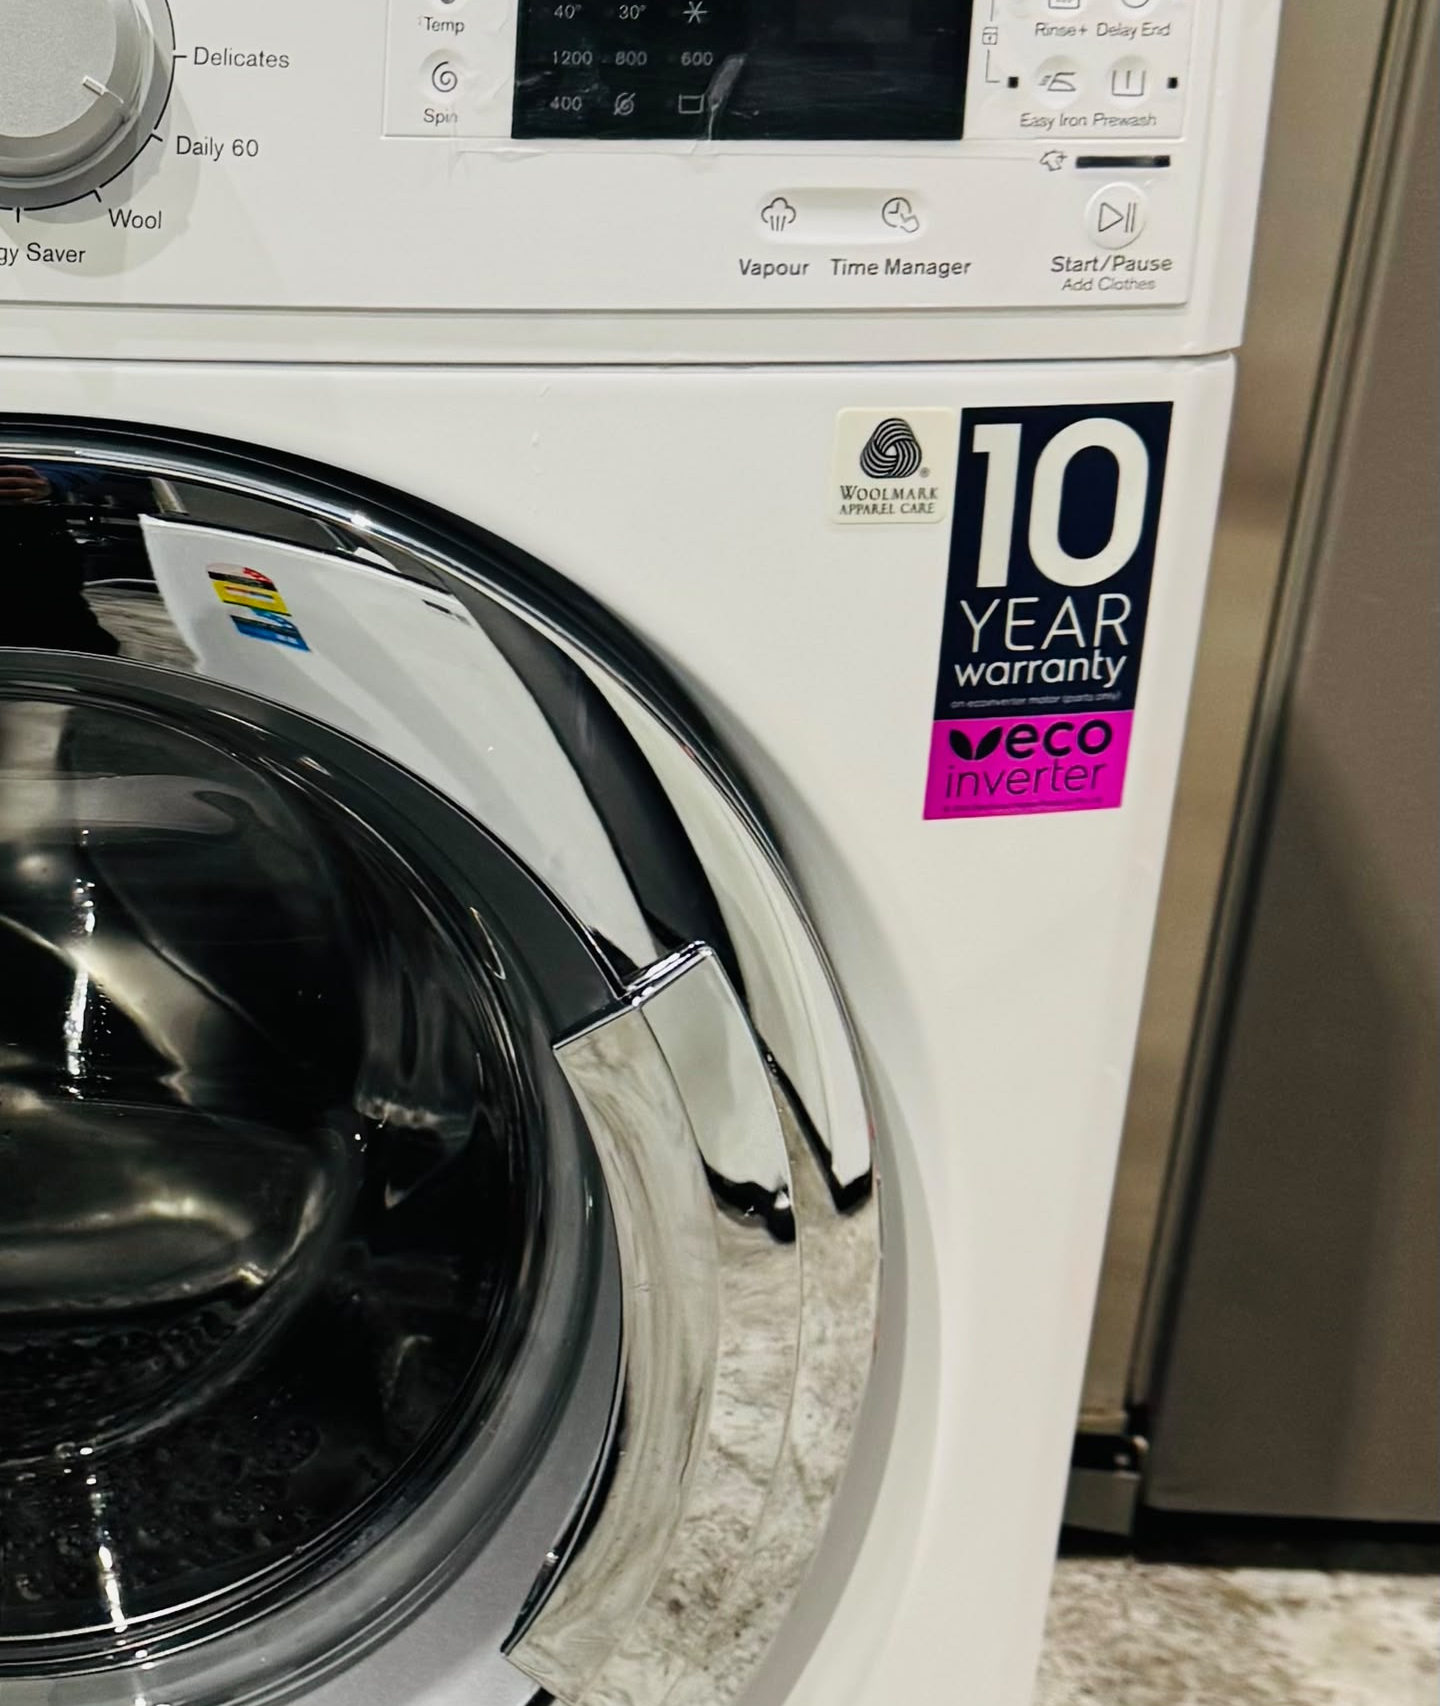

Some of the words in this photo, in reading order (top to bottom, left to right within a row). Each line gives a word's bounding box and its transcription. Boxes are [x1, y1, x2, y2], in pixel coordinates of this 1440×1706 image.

[424, 16, 465, 36] Temp
[1096, 22, 1136, 40] Delay
[1141, 21, 1171, 37] End
[192, 46, 290, 69] Delicates
[553, 50, 593, 66] 1200
[615, 50, 647, 66] 800
[681, 50, 713, 66] 600
[550, 95, 582, 111] 400
[423, 107, 458, 127] Spin
[1019, 112, 1055, 130] Easy
[1059, 113, 1087, 127] Iron
[1092, 112, 1158, 128] Prewash
[176, 135, 225, 161] Daily
[231, 138, 259, 158] 60
[109, 208, 162, 230] Wool
[26, 243, 86, 264] Saver
[738, 258, 810, 278] Vapour
[830, 258, 878, 276] Time
[885, 258, 971, 279] Manager
[1050, 255, 1174, 274] Start/Pause
[1061, 276, 1093, 292] Add
[1097, 276, 1156, 292] Clothes
[840, 485, 938, 501] WOOLMARK
[972, 416, 1150, 589] 10
[839, 502, 894, 515] APPAREL
[900, 502, 935, 514] CARE
[960, 593, 1133, 654] YEAR
[954, 648, 1127, 687] warranty
[1005, 719, 1113, 760] eco
[945, 758, 1108, 799] inverter
